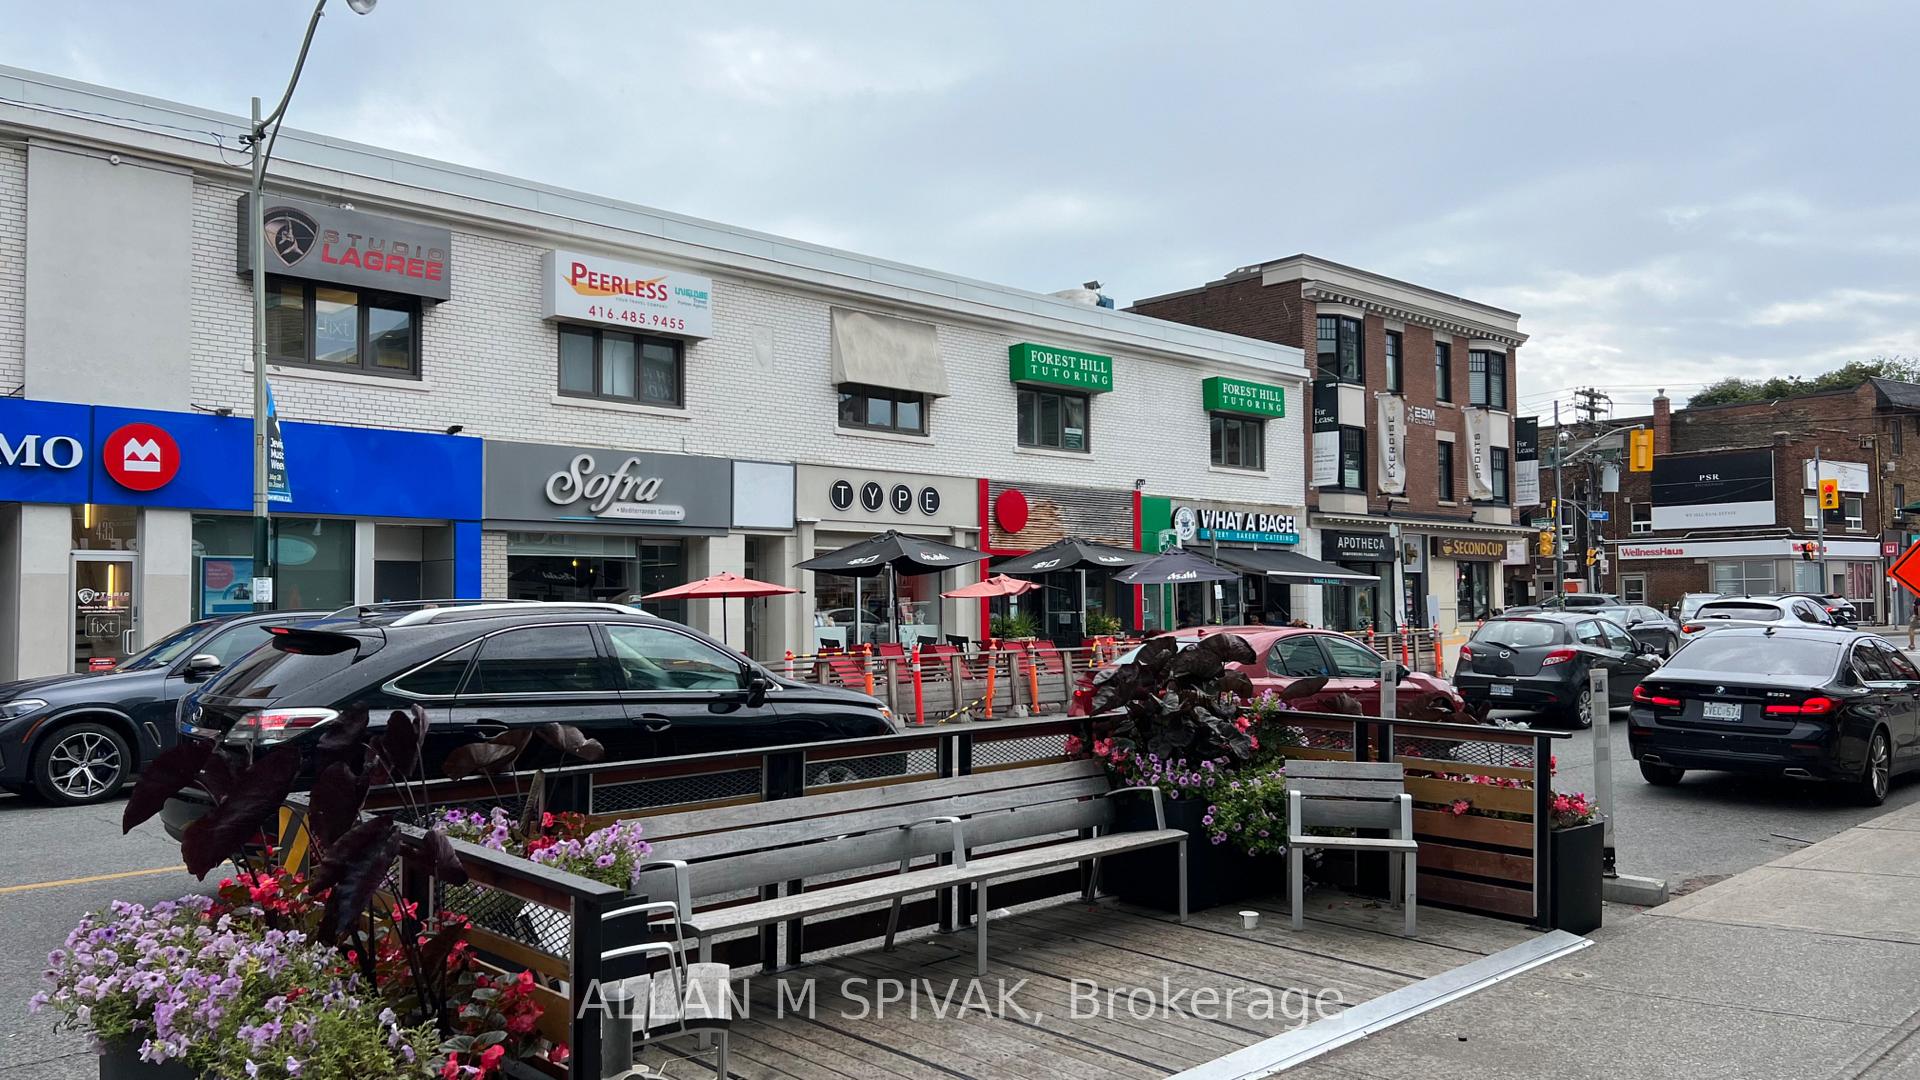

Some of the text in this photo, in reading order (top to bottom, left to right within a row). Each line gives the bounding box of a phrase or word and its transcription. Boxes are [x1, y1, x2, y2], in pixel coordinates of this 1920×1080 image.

[323, 229, 444, 261] STUDIO
[321, 244, 443, 281] LAGREE
[571, 262, 668, 301] PEERLESS
[589, 305, 685, 330] 416.485.9455
[1031, 350, 1108, 373] FOREST HILL
[1031, 364, 1108, 385] TUTORING
[1222, 382, 1281, 402] FOREST HILL
[1222, 396, 1281, 412] TUTORING
[1314, 408, 1326, 416] For
[1314, 416, 1334, 424] Lease
[1415, 407, 1435, 420] ESM
[1415, 418, 1435, 426] CLINICS
[1388, 415, 1396, 478] EXERCISE
[546, 454, 664, 512] Sofra
[1699, 473, 1720, 481] PSR
[836, 485, 935, 511] TYPE
[1201, 509, 1242, 530] WHAT
[1246, 513, 1256, 532] A
[1260, 514, 1299, 534] BAGEL
[1207, 530, 1294, 542] ETERY BAKERY CATERING
[1337, 537, 1385, 550] APOTHECA
[1453, 540, 1503, 556] SECOND CUP
[1621, 547, 1684, 556] WellnessHaus
[1167, 570, 1198, 580] Asahi
[90, 617, 115, 633] fixt
